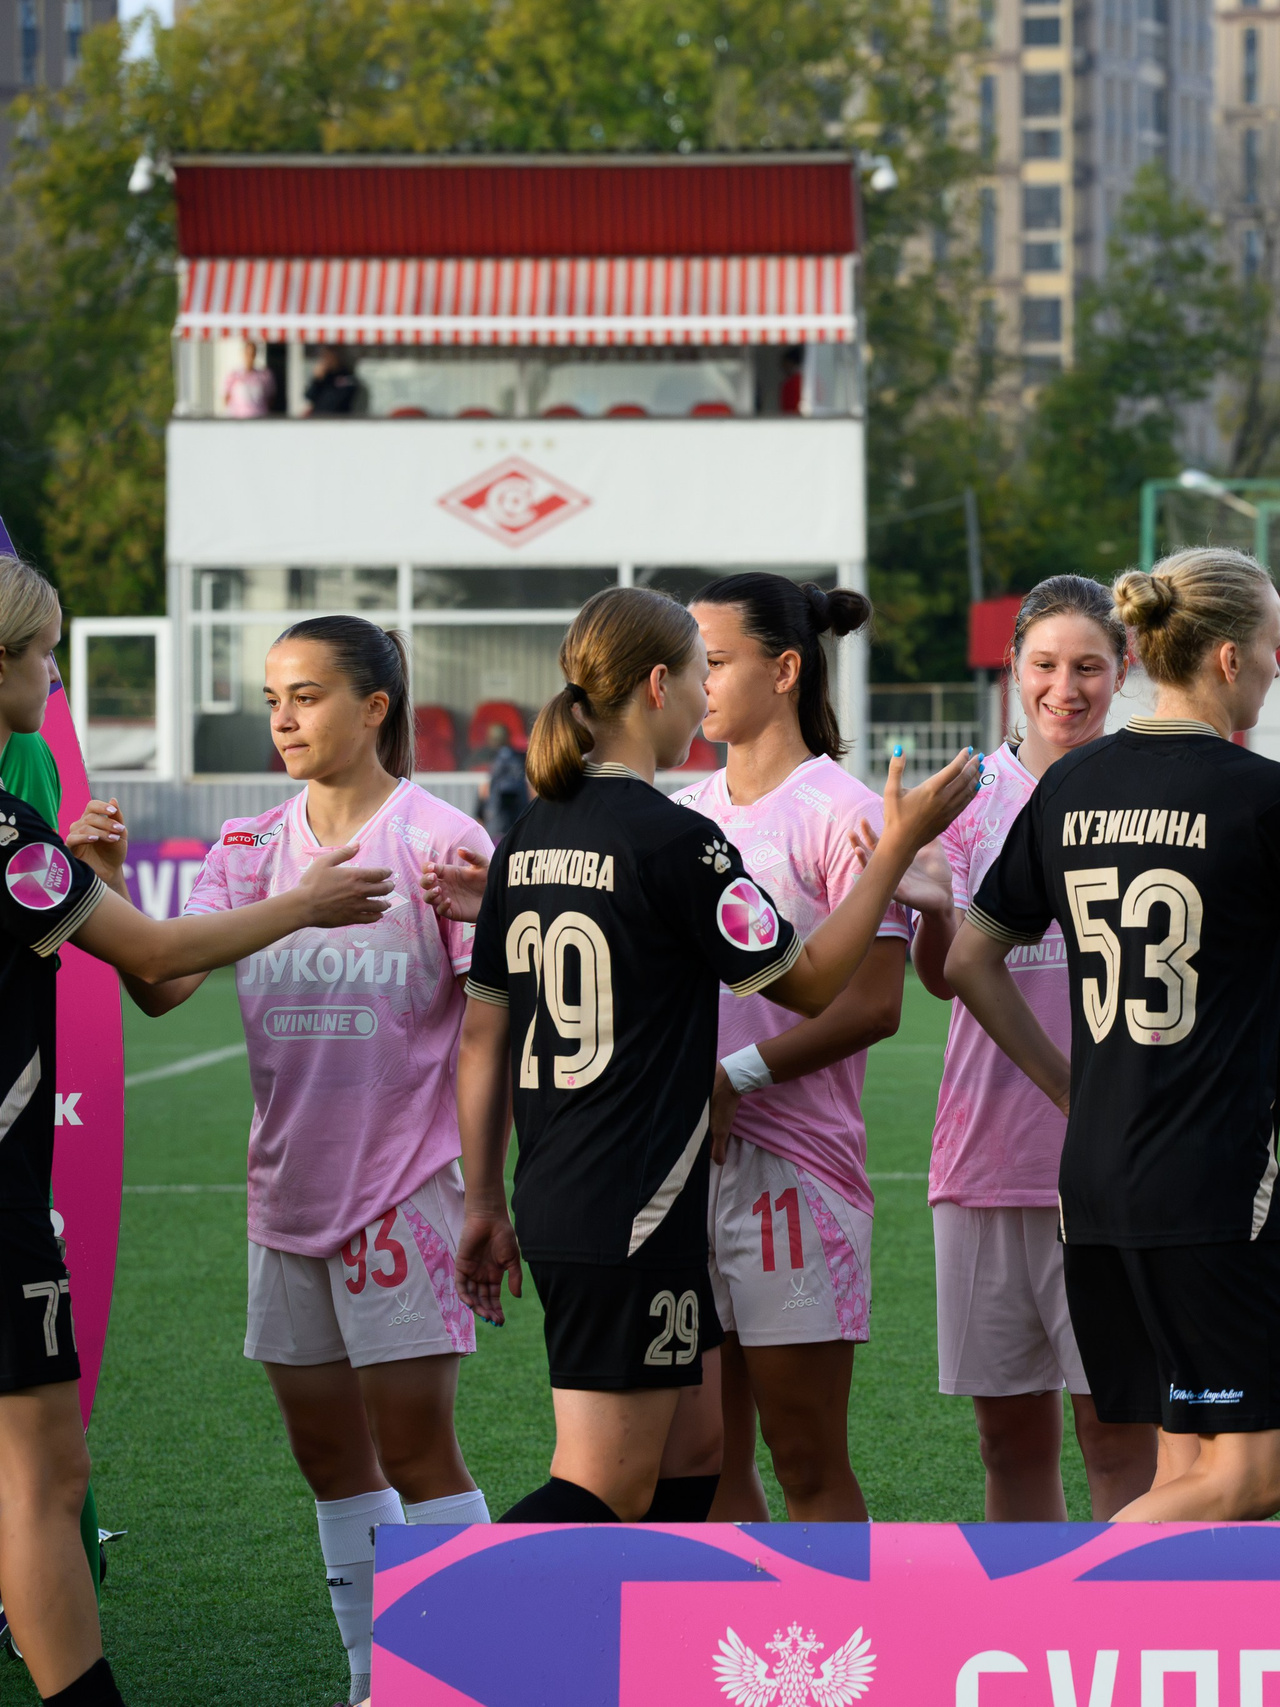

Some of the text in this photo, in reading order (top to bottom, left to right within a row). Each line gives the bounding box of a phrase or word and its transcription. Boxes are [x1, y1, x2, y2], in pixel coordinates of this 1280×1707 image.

[791, 788, 837, 823] ПРОТЕКТ
[799, 782, 832, 803] КИБЕР
[387, 822, 440, 859] ПРОТЕКТ
[392, 814, 429, 840] КИБЕР
[973, 838, 1004, 850] JOGE
[1062, 809, 1206, 849] КУЗИЩИНА
[46, 862, 58, 888] СУПЕР
[53, 868, 65, 888] ЛИГА
[242, 941, 408, 986] ЛУКОЙЛ
[1064, 866, 1204, 1046] 53
[505, 911, 615, 1089] 29
[752, 1187, 805, 1272] 11
[341, 1207, 408, 1295] 93
[643, 1289, 699, 1366] 29
